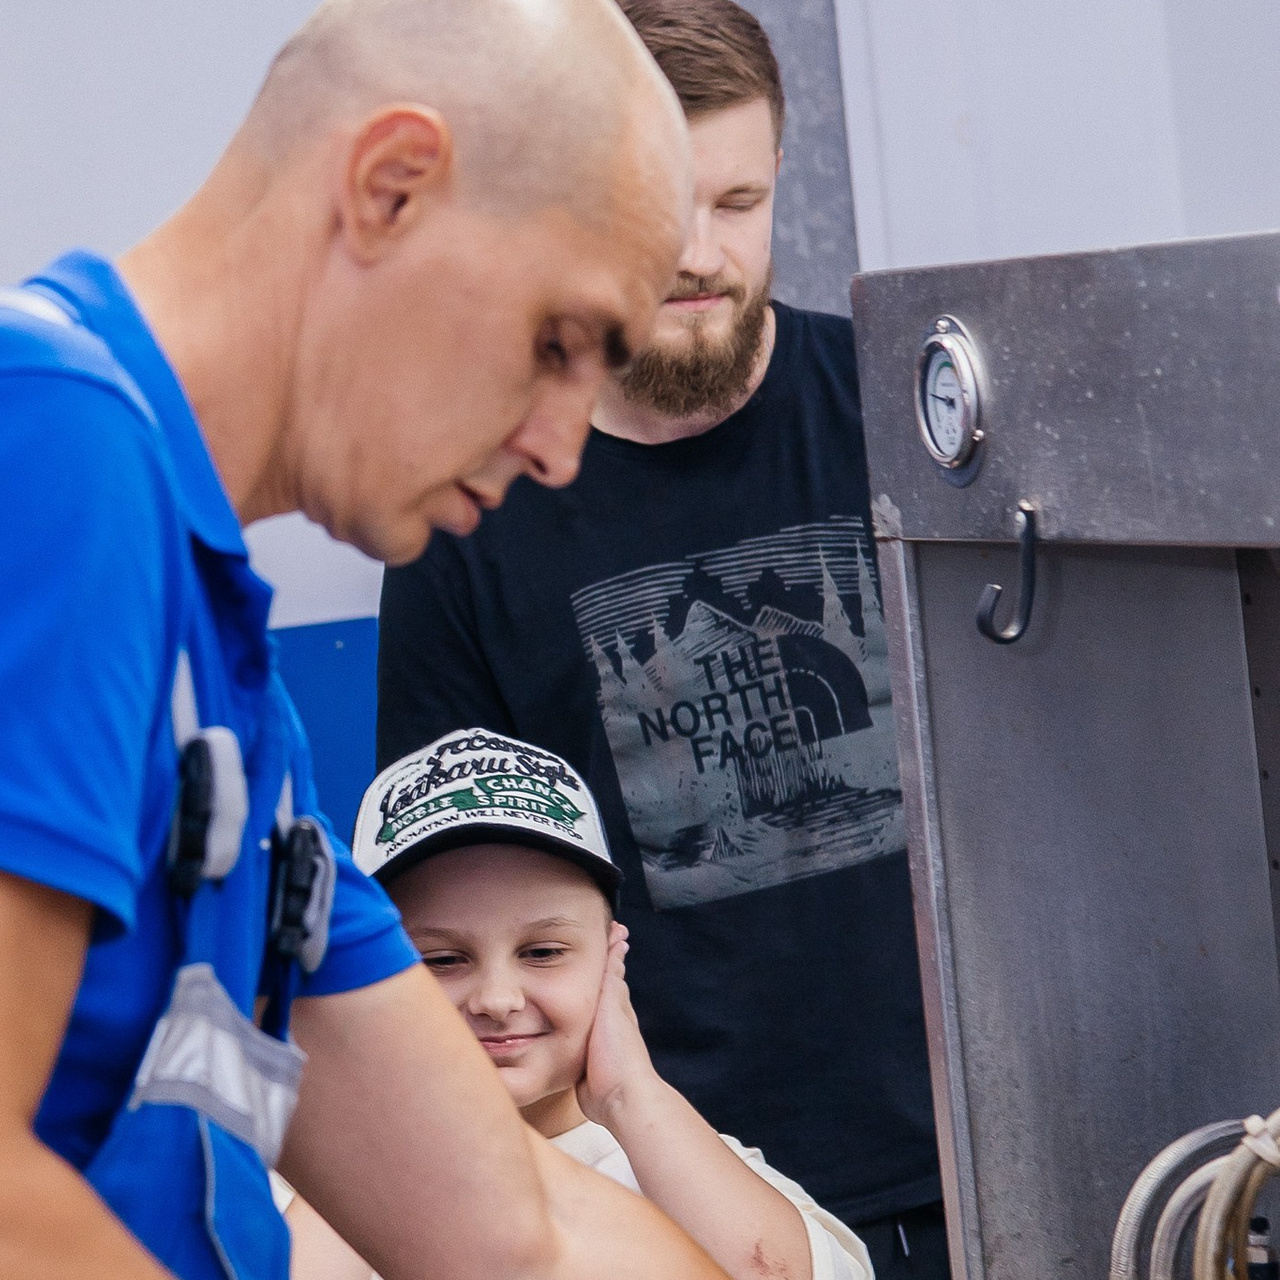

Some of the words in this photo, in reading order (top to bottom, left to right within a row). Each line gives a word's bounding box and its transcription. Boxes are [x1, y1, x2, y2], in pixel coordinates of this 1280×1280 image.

[694, 639, 780, 691] THE
[637, 675, 793, 747] NORTH
[691, 712, 798, 774] FACE
[465, 808, 501, 819] WILL
[503, 809, 552, 827] NEVER
[553, 822, 584, 841] STOP
[477, 794, 550, 813] SPIRIT
